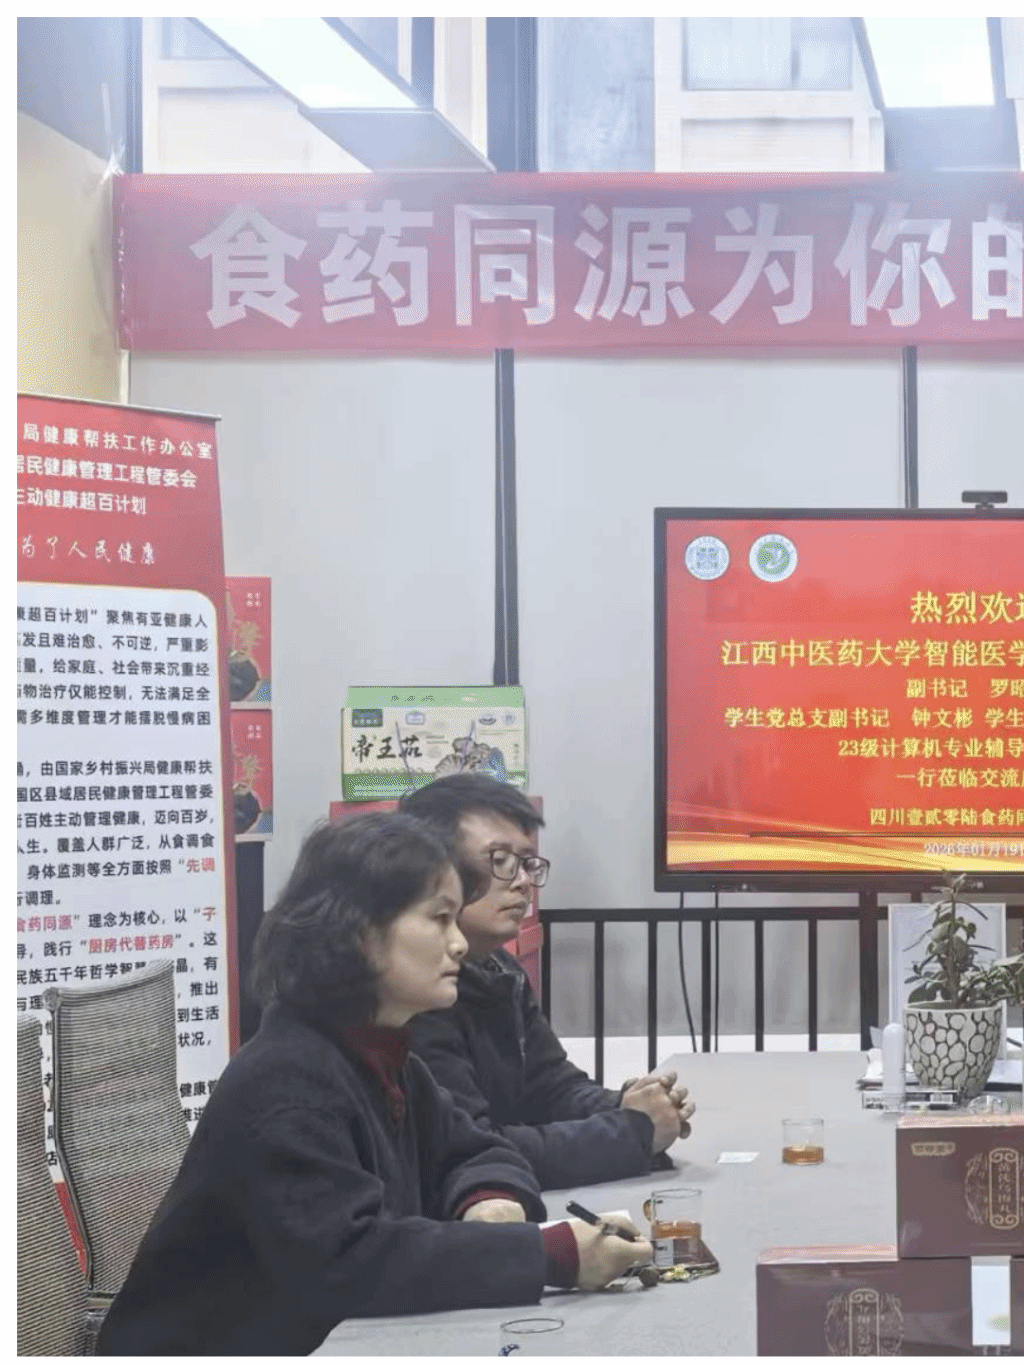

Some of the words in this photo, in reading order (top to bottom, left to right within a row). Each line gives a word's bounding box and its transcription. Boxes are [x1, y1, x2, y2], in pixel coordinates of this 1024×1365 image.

[23, 422, 212, 459] 局健康帮扶工作办公室
[17, 631, 210, 653] 发且难治愈、不可逆，严重影
[17, 656, 210, 677] 量，给家庭、社会带来沉重经
[17, 683, 210, 702] 物治疗仅能控制，无法满足全
[905, 678, 969, 700] 副书记
[723, 707, 890, 731] 学生党总支副书记
[177, 1005, 220, 1024] 到生活
